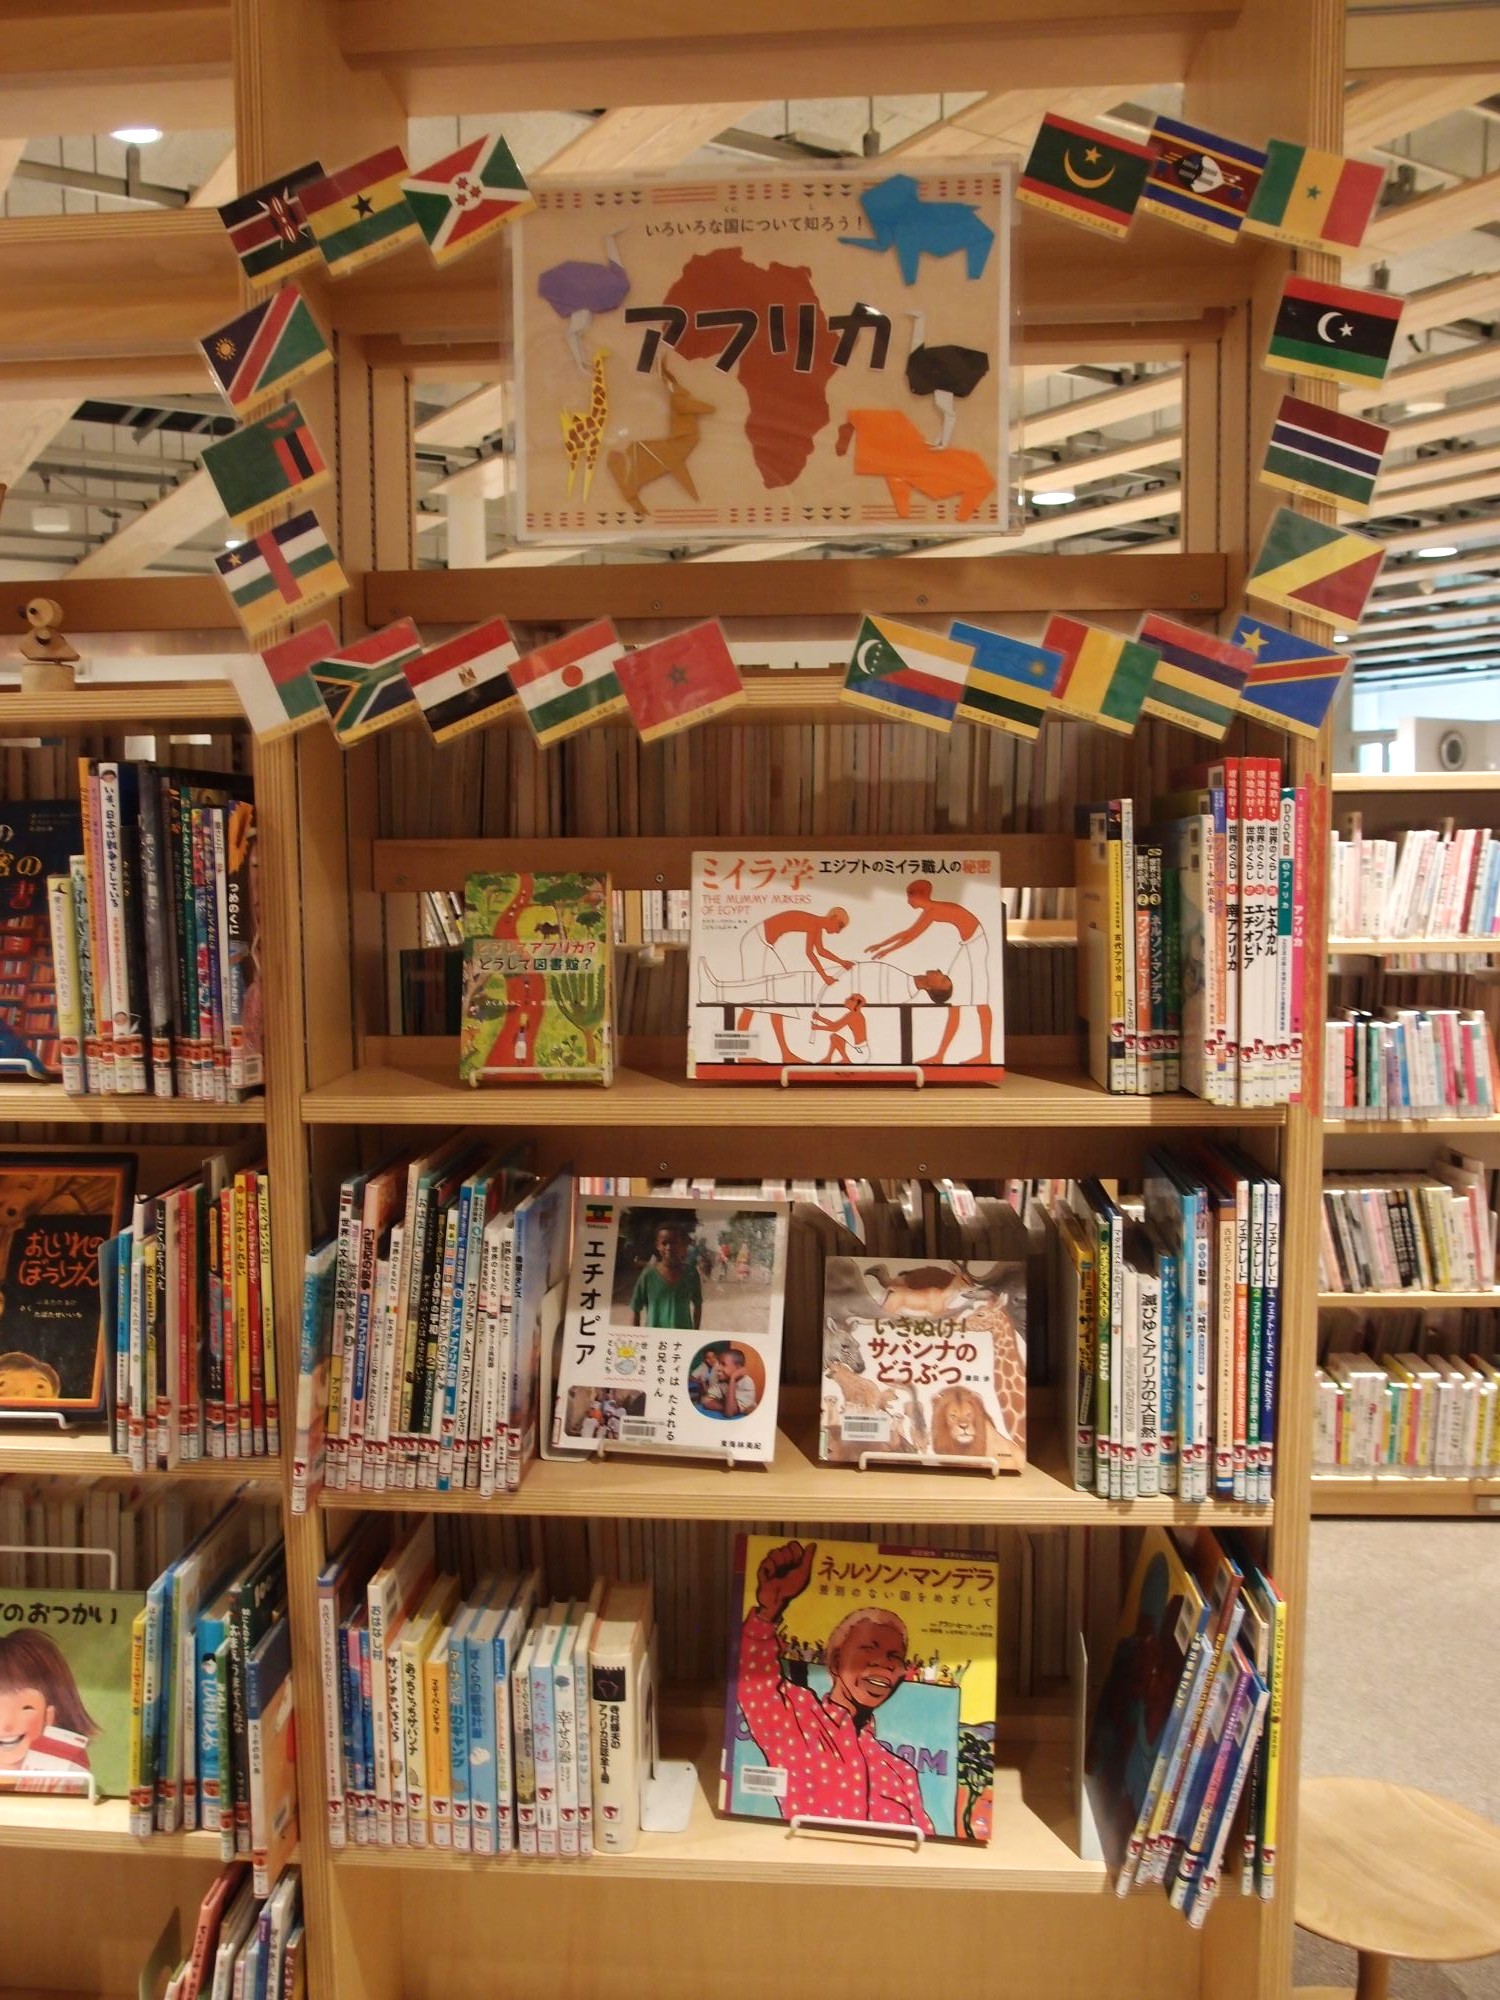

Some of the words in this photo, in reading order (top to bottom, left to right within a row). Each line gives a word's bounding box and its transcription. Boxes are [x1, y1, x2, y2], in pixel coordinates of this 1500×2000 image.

[646, 213, 864, 237] いろいろな国について知ろう！
[624, 301, 892, 374] アフリカ
[702, 857, 814, 891] ミイラ学
[819, 857, 992, 875] エジプトのミイラ職人の秘密
[1228, 826, 1238, 879] 世界のくらし
[1245, 826, 1255, 880] 世界のくらし
[1256, 826, 1265, 879] 世界のくらし
[1269, 827, 1278, 880] 世界のくらし
[1226, 905, 1239, 971] 南アフリカ
[1244, 905, 1255, 969] エチオピア
[1255, 905, 1265, 956] エジプト
[1265, 905, 1278, 956] セネガル
[1293, 905, 1304, 946] アフリカ
[24, 1229, 107, 1259] おしいれの
[1238, 1219, 1247, 1283] フェアトレード
[1252, 1222, 1262, 1285] フェアトレード
[1267, 1222, 1278, 1286] フェアトレード
[17, 1258, 100, 1289] ぼうけん
[575, 1240, 606, 1366] エチオピア
[874, 1317, 967, 1339] いきぬけ！
[654, 1341, 668, 1398] お兄ちゃん
[868, 1338, 978, 1362] サバンナの
[876, 1361, 963, 1385] どうぶつ
[1141, 1294, 1157, 1438] 滅びゆくアフリカの大自然
[817, 1557, 995, 1591] ネルソン・マンデラ
[819, 1583, 994, 1608] 差別のない国をめざして
[0, 1601, 117, 1626] のおつかい
